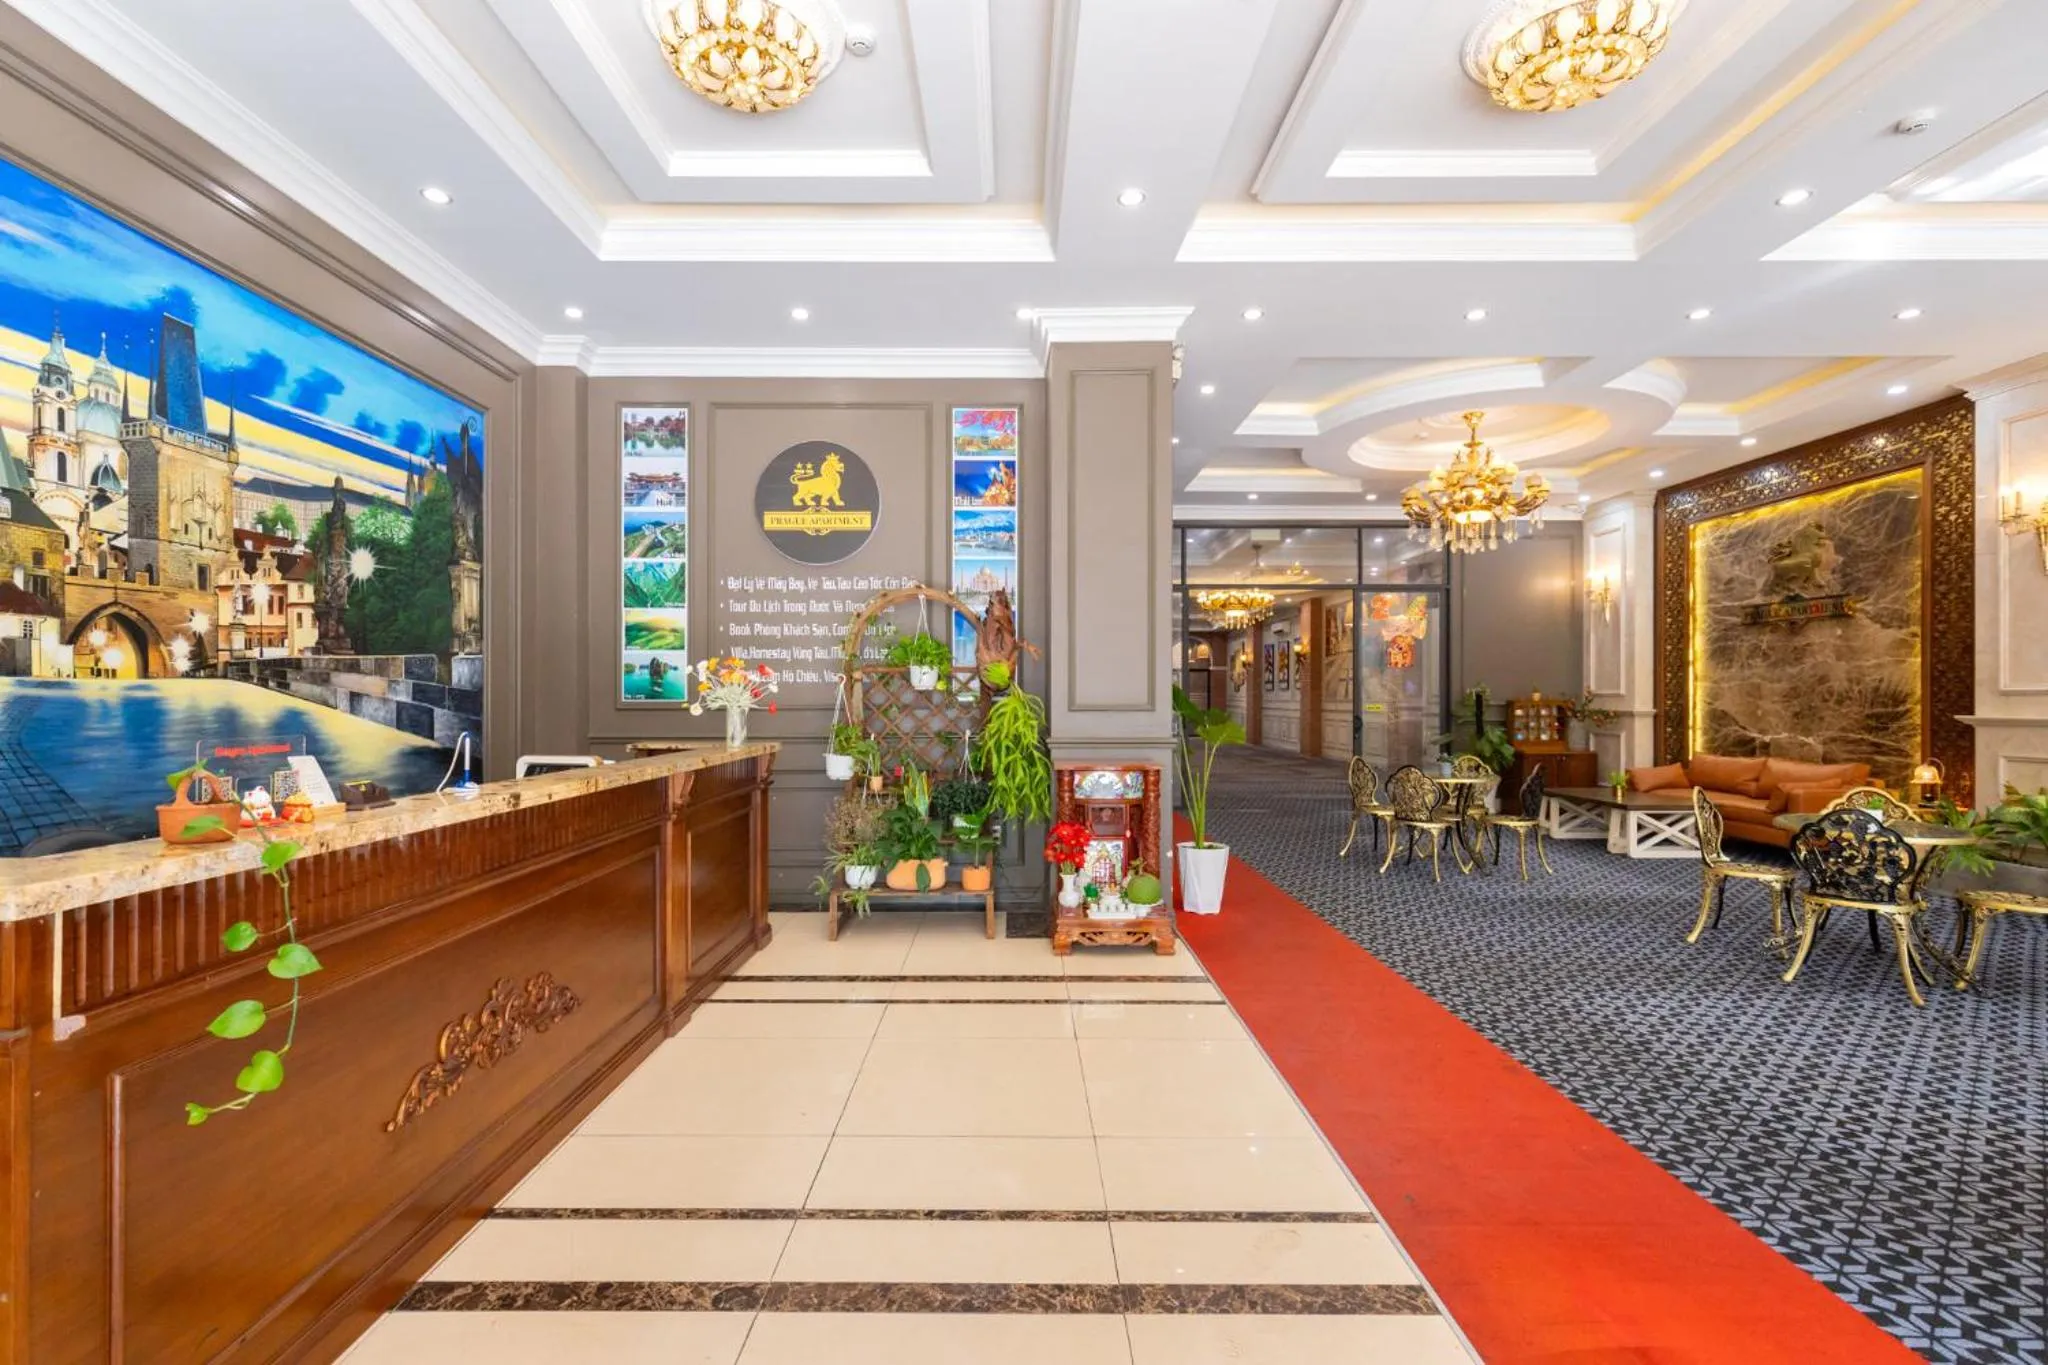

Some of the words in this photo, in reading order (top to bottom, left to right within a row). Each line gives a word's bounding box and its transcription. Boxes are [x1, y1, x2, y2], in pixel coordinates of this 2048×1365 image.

[770, 516, 806, 525] PRAGUE
[809, 516, 864, 525] APARTMENT
[729, 600, 747, 613] Tour
[729, 623, 751, 636] Book
